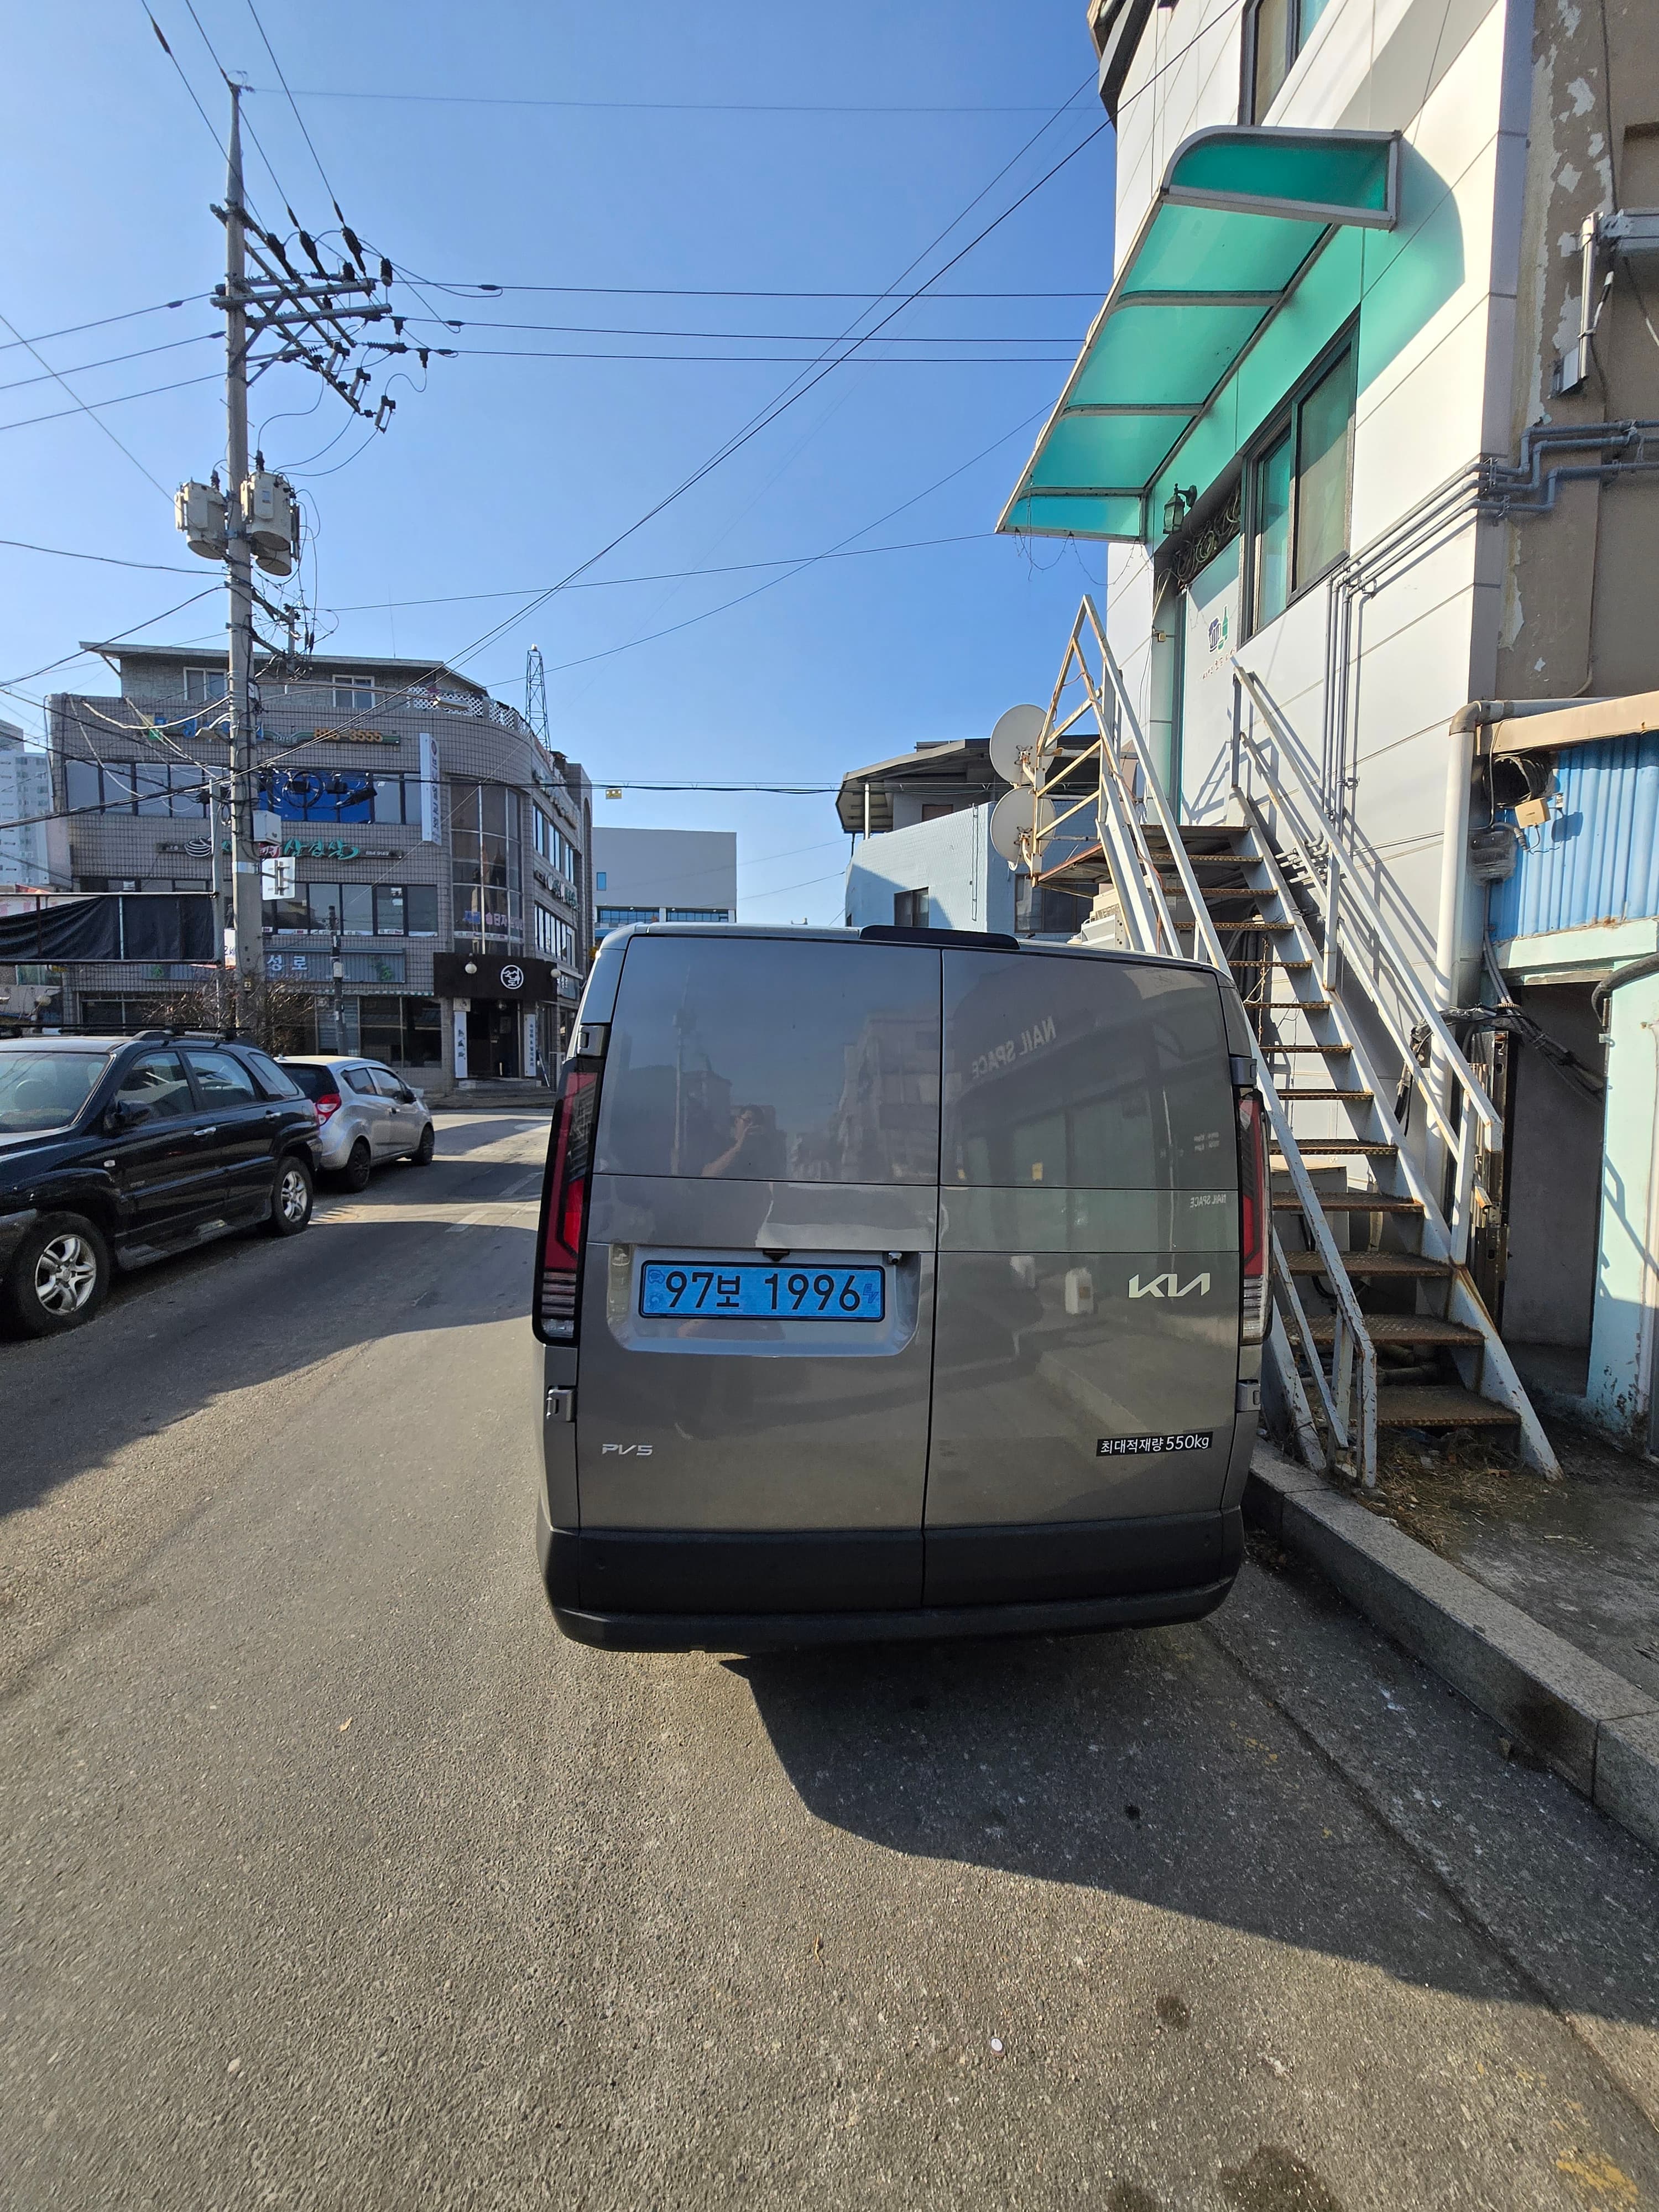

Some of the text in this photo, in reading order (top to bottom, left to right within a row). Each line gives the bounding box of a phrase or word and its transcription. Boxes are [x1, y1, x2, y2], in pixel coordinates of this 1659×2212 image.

[665, 1270, 879, 1311] 97보 1996 EV
[602, 1444, 653, 1455] PV5
[1100, 1434, 1209, 1454] 최대적재량 550kg
